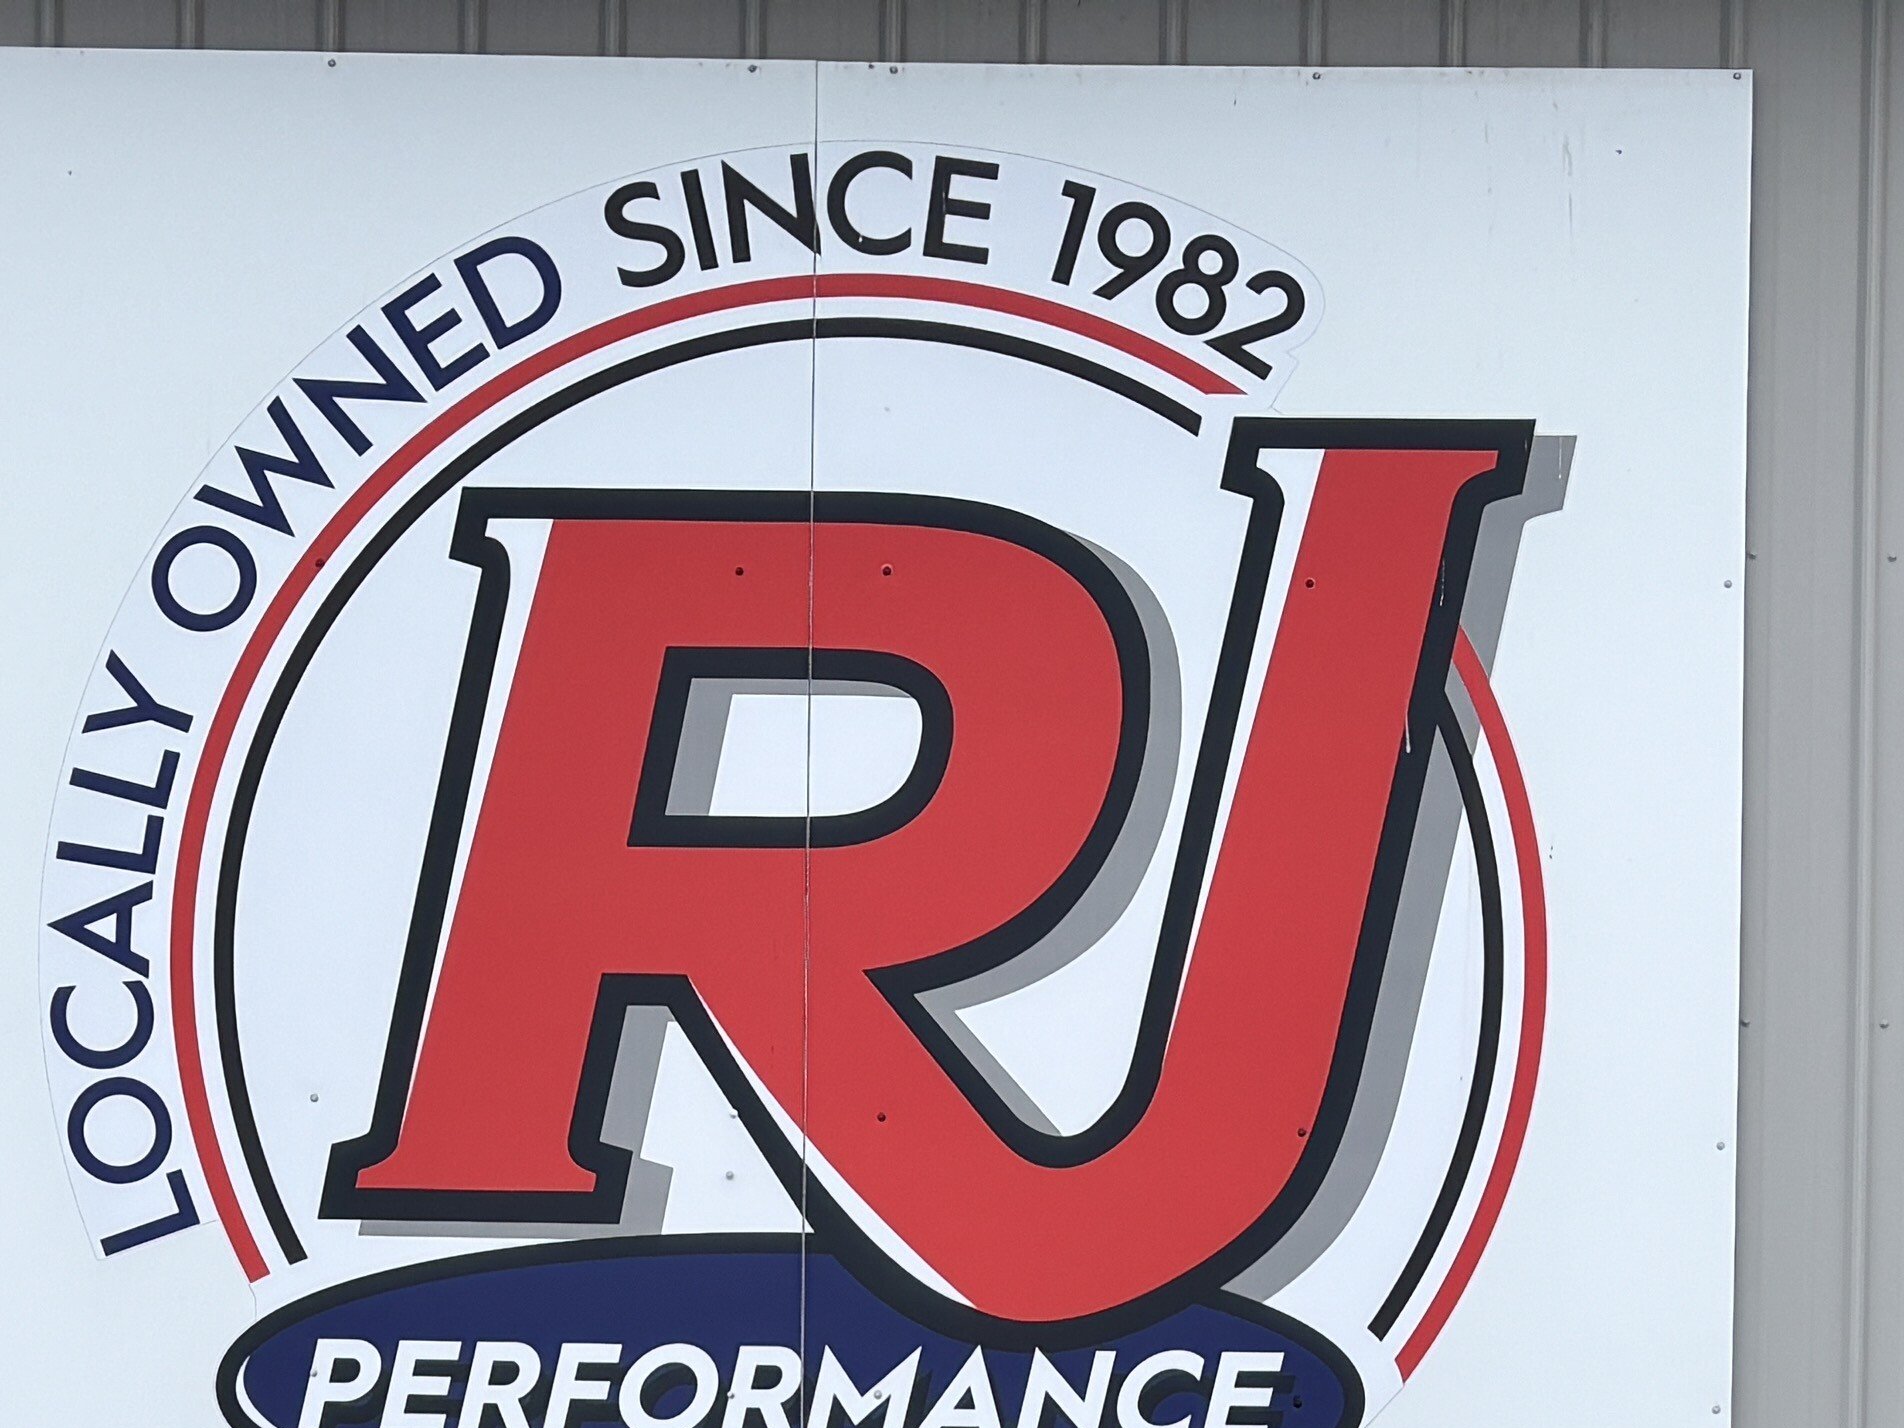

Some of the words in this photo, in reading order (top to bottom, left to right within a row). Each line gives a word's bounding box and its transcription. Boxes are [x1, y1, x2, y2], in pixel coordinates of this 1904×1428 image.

[46, 649, 201, 1257] LOCALLY
[151, 236, 562, 633] OWNED
[604, 150, 1000, 288] SINCE
[1051, 179, 1306, 381] 1982
[318, 417, 1536, 1345] RJ
